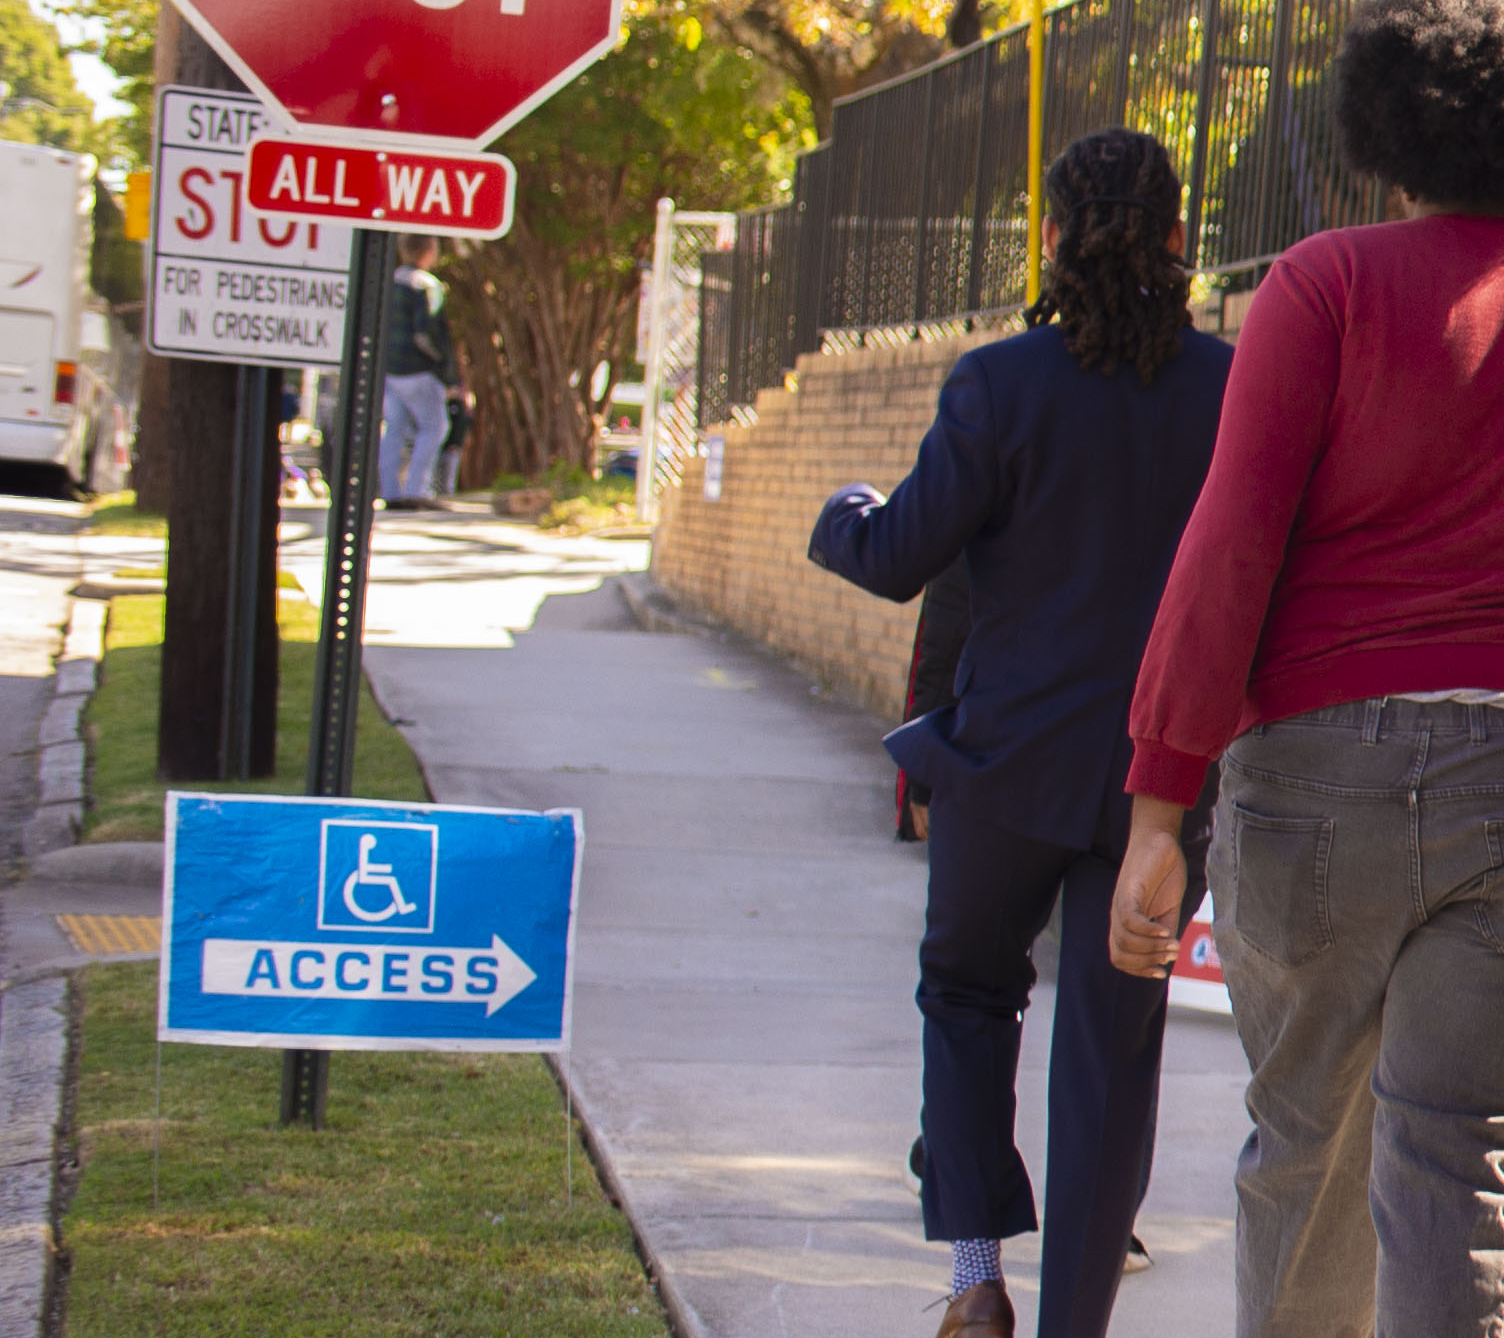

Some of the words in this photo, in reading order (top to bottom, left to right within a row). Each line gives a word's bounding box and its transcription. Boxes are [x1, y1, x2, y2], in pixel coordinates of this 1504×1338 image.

[269, 154, 361, 208] ALL
[387, 165, 486, 218] WAY
[175, 167, 320, 251] ST
[164, 266, 200, 297] FOR
[216, 270, 346, 311] PEDESTRIANS
[179, 308, 197, 337] IN
[212, 311, 329, 348] CROSSWALK
[245, 949, 498, 994] ACCESS
